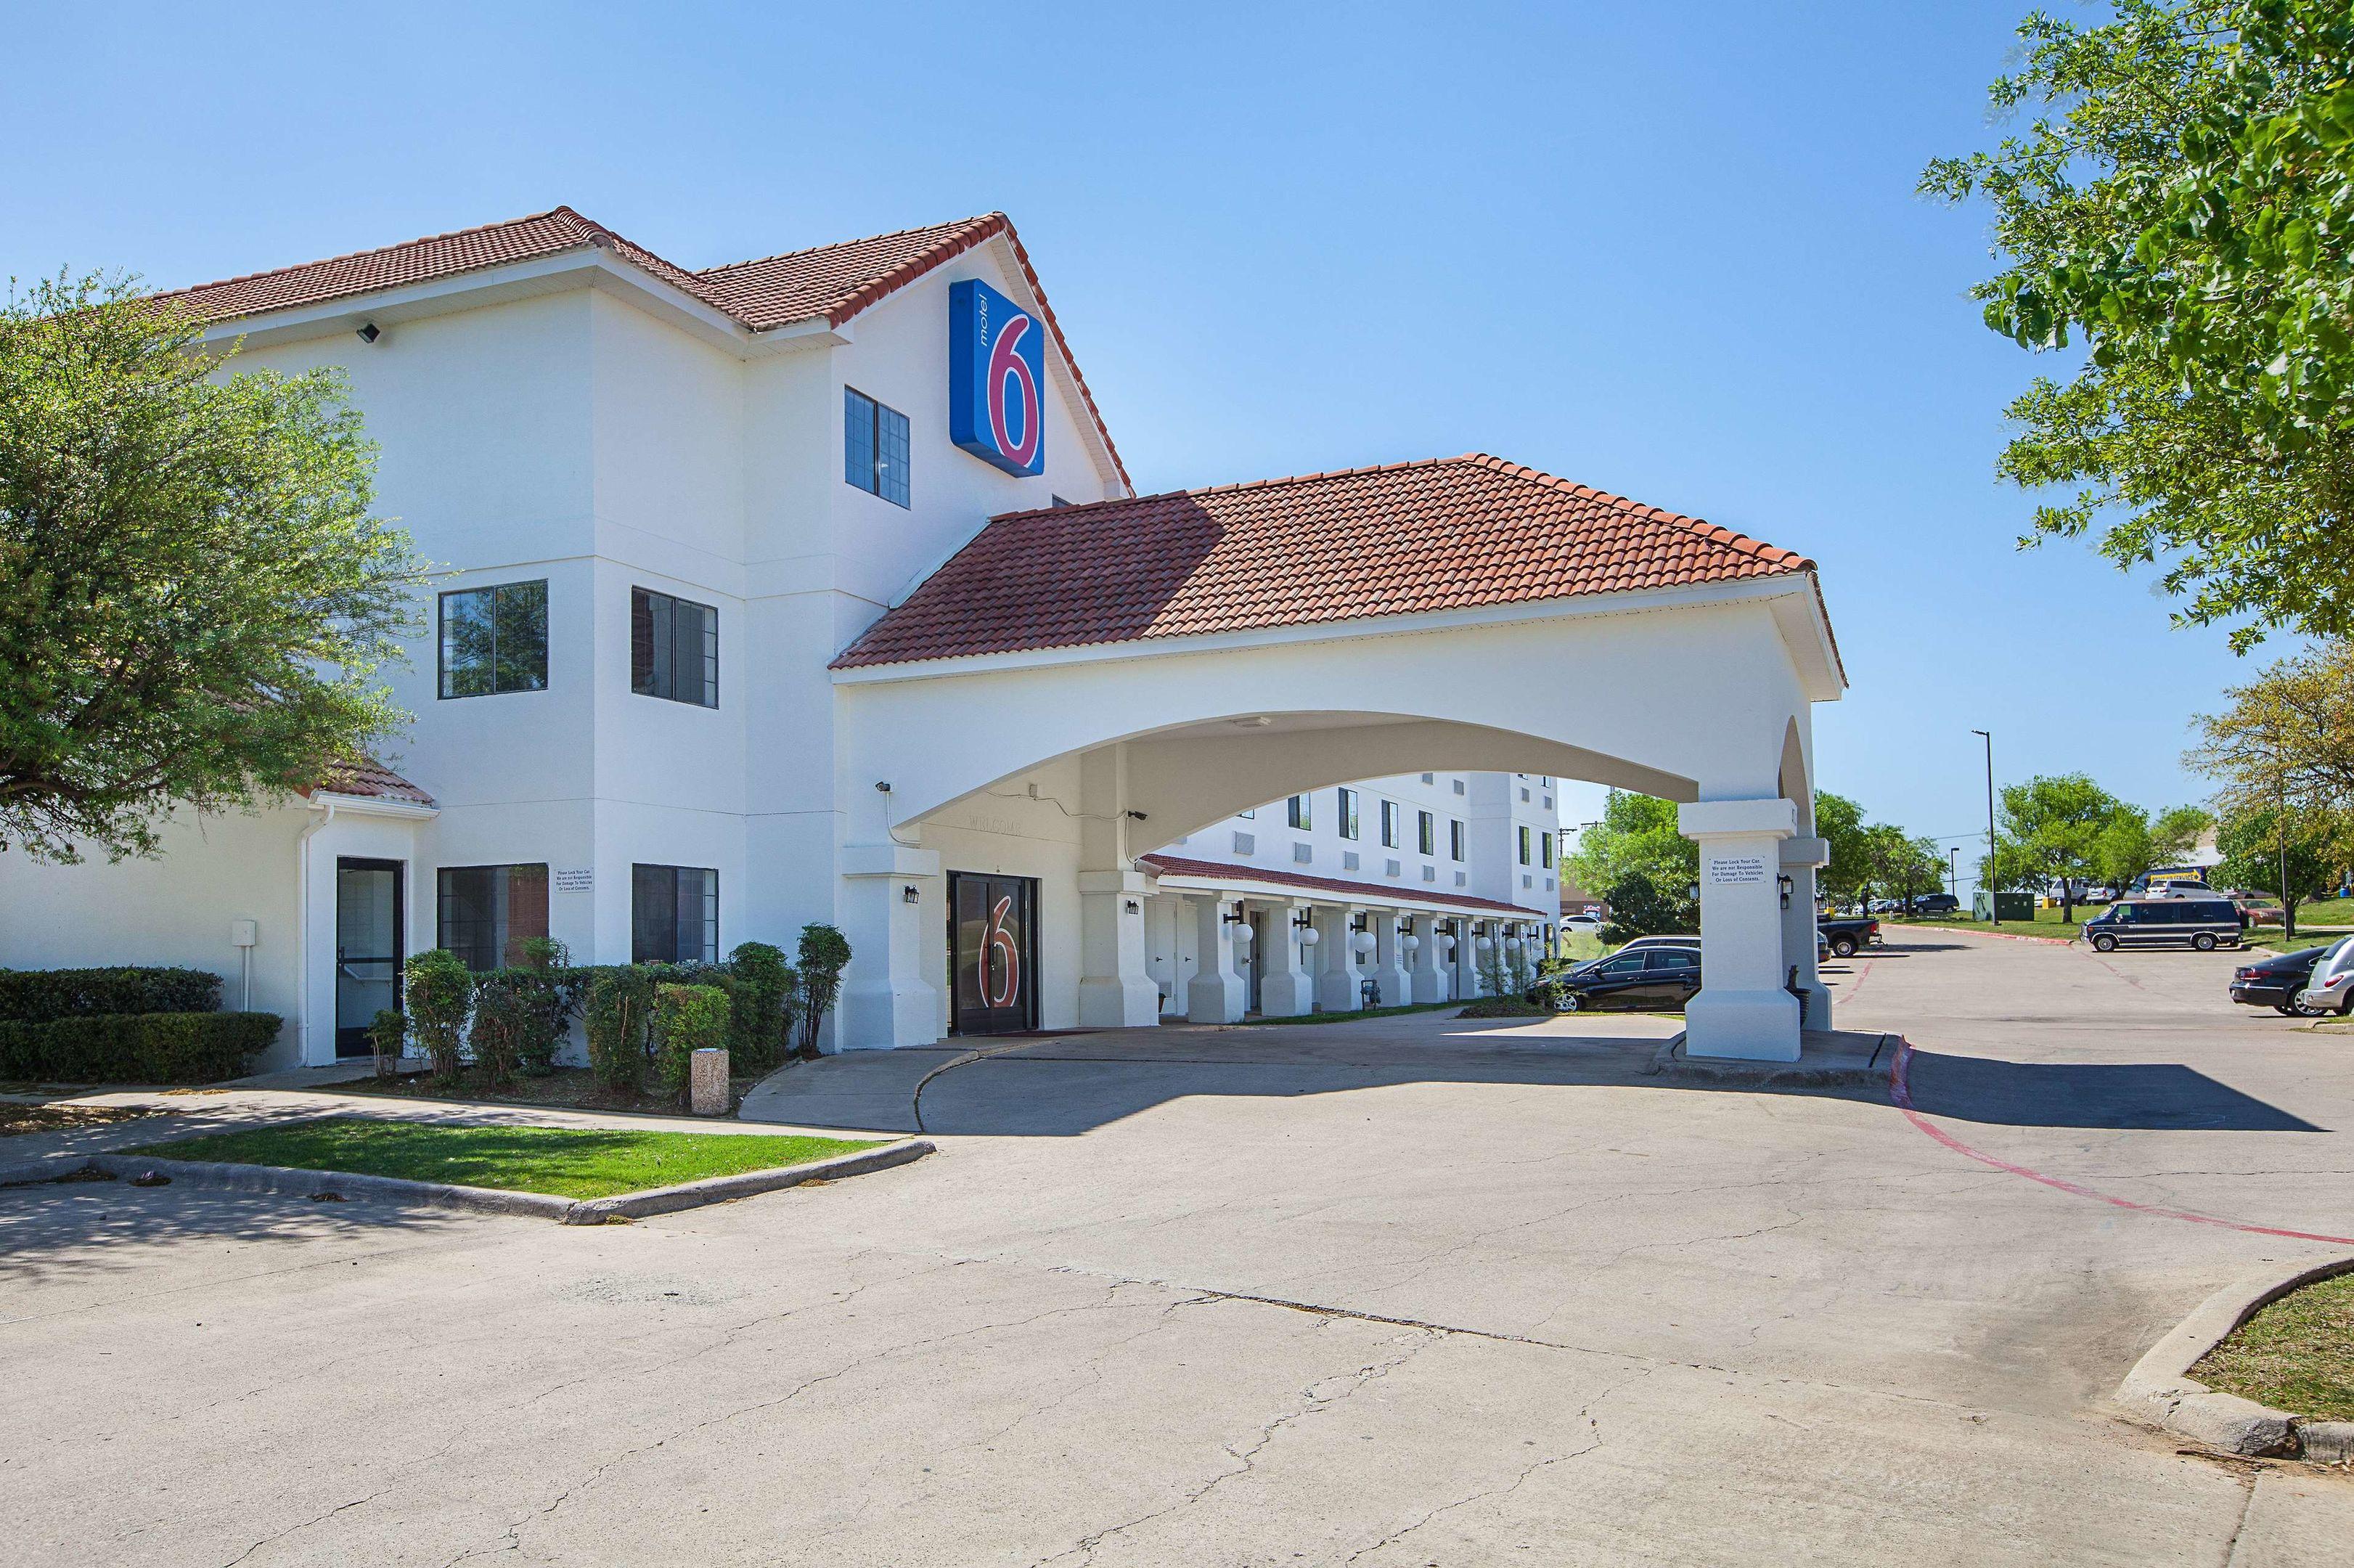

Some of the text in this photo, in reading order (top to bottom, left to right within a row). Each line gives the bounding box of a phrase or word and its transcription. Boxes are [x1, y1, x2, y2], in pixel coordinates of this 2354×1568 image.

[978, 293, 988, 347] motel
[987, 314, 1039, 468] 6
[978, 895, 1020, 1008] 6
